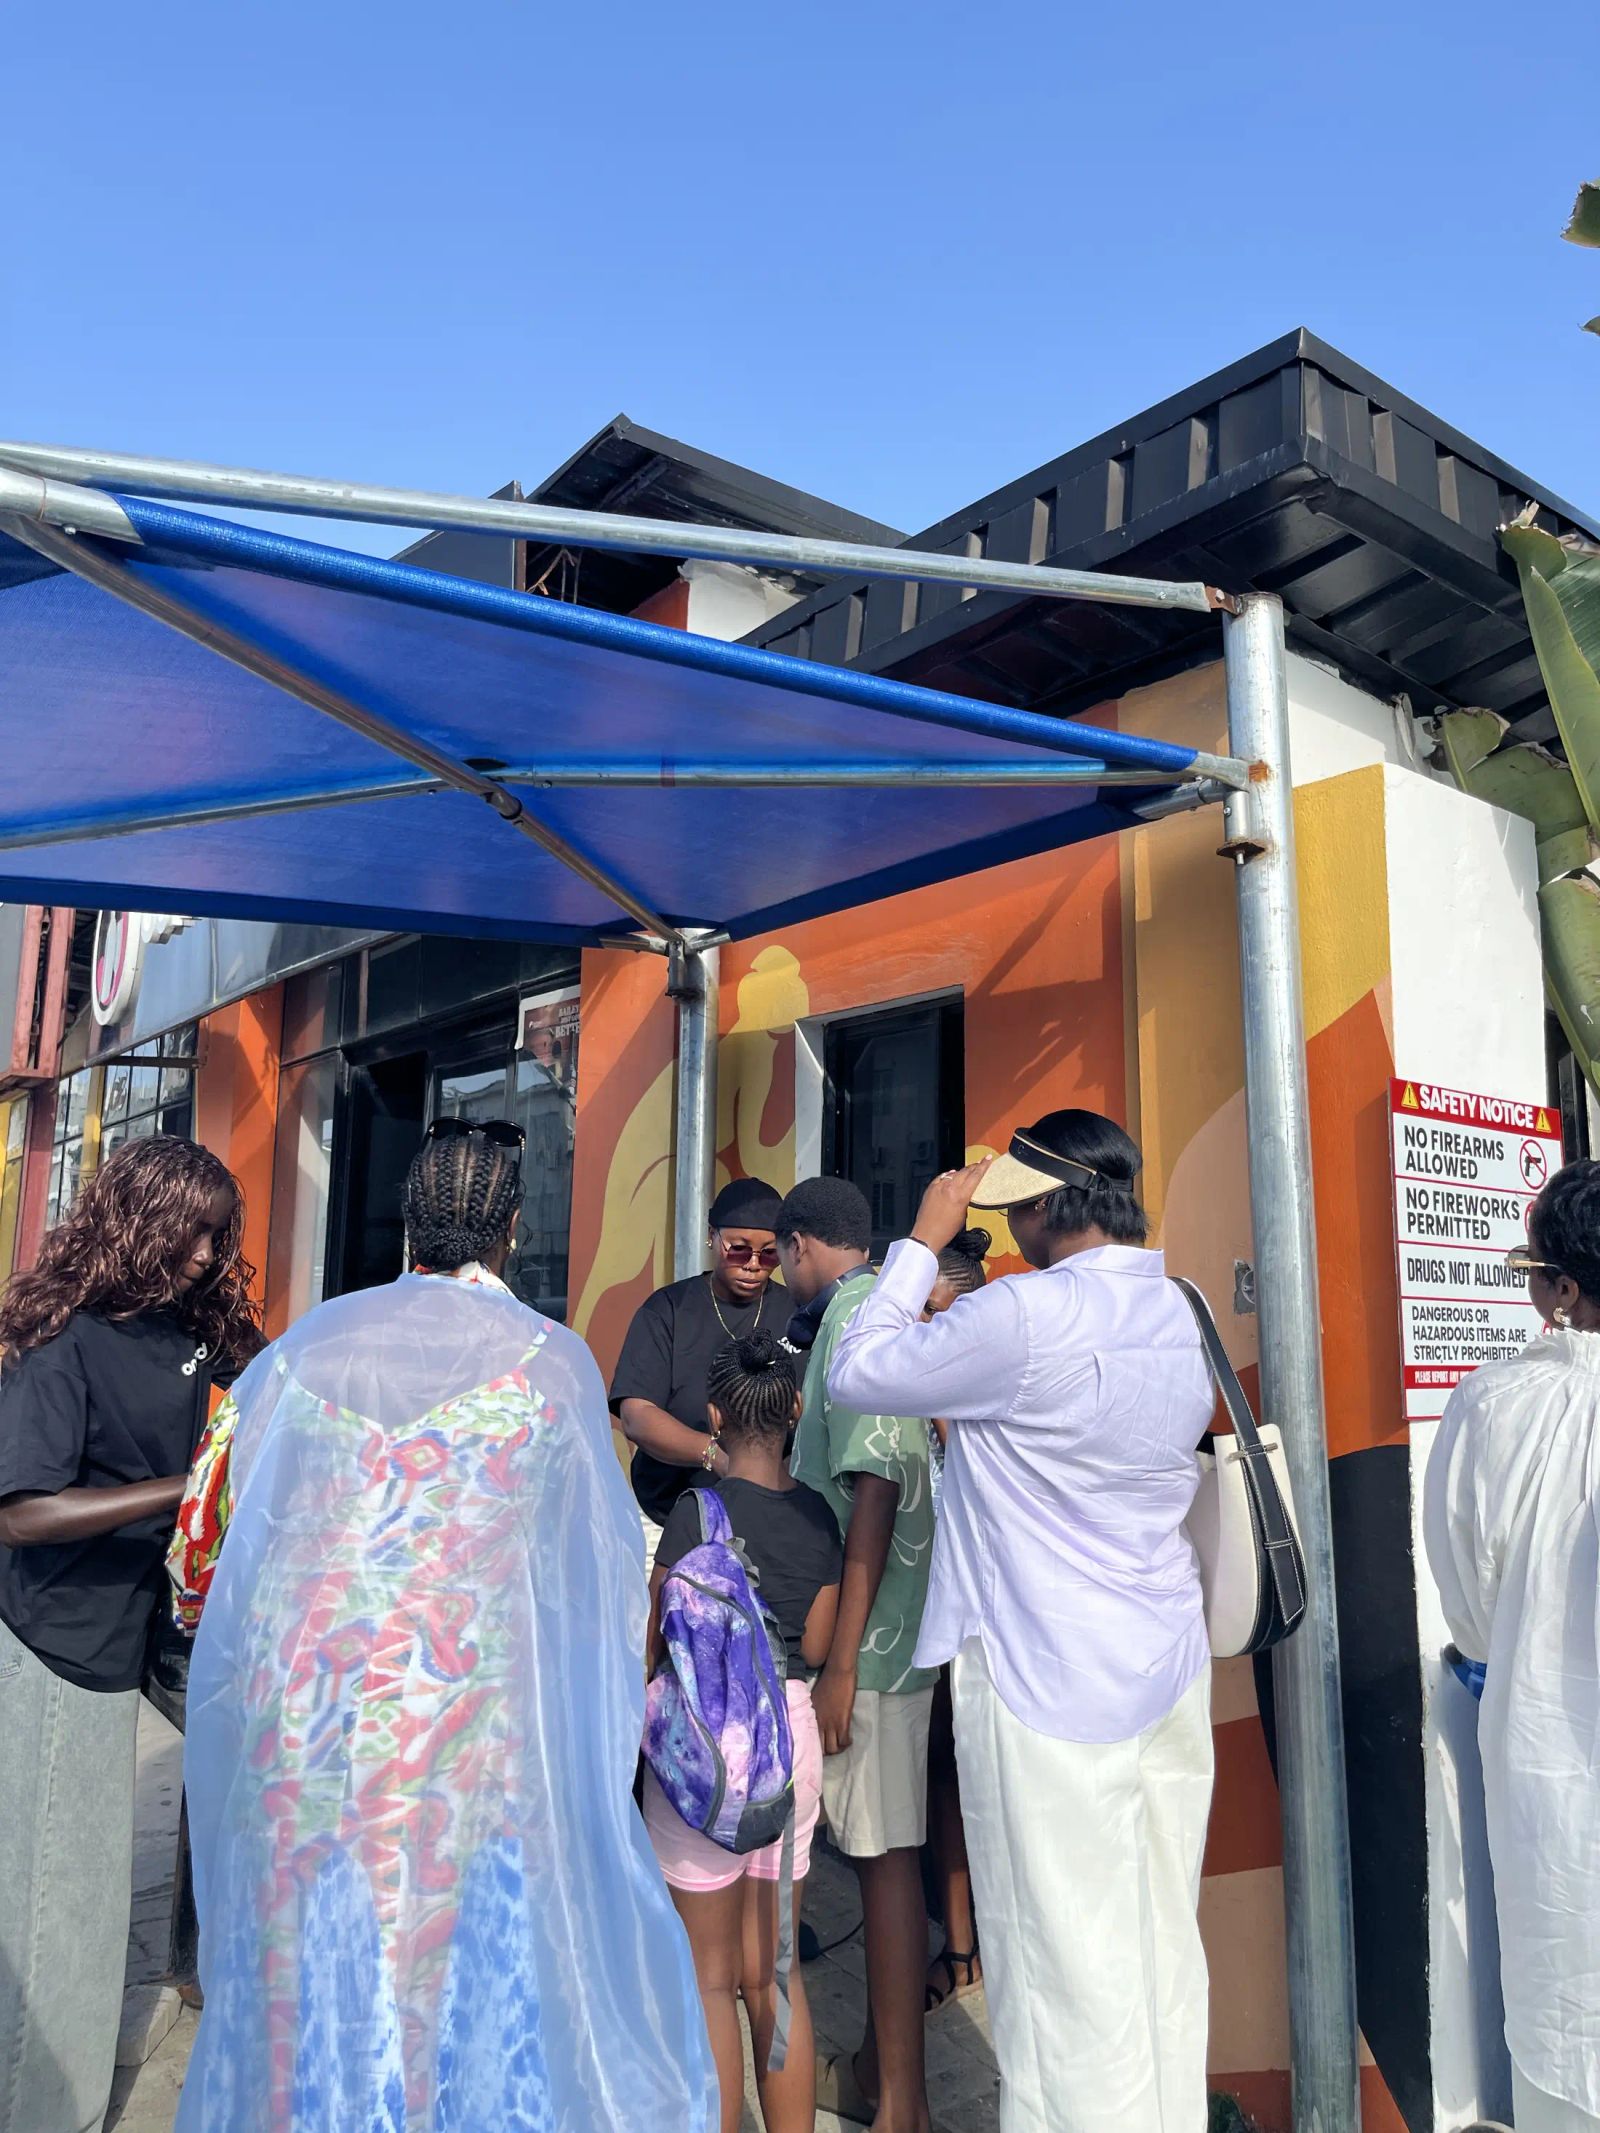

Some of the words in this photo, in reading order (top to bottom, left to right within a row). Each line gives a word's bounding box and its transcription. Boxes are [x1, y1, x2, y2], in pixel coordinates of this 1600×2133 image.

[1419, 1085, 1479, 1118] SAFETY
[1479, 1098, 1534, 1128] NOTICE
[1404, 1125, 1427, 1149] NO
[1431, 1130, 1505, 1161] FIREARMS
[1405, 1150, 1478, 1180] ALLOWED
[1406, 1187, 1429, 1210] NO
[1433, 1191, 1520, 1220] FIREWORKS
[1407, 1212, 1490, 1240] PERMITTED
[1407, 1258, 1446, 1284] DRUGS
[1449, 1261, 1471, 1286] NOT
[1412, 1306, 1473, 1323] DANGEROUS
[1475, 1309, 1489, 1323] OR
[1413, 1325, 1475, 1342] HAZARDOUS
[1476, 1327, 1506, 1343] ITEMS
[1508, 1328, 1527, 1343] ARE
[1414, 1345, 1459, 1361] STRICTLY
